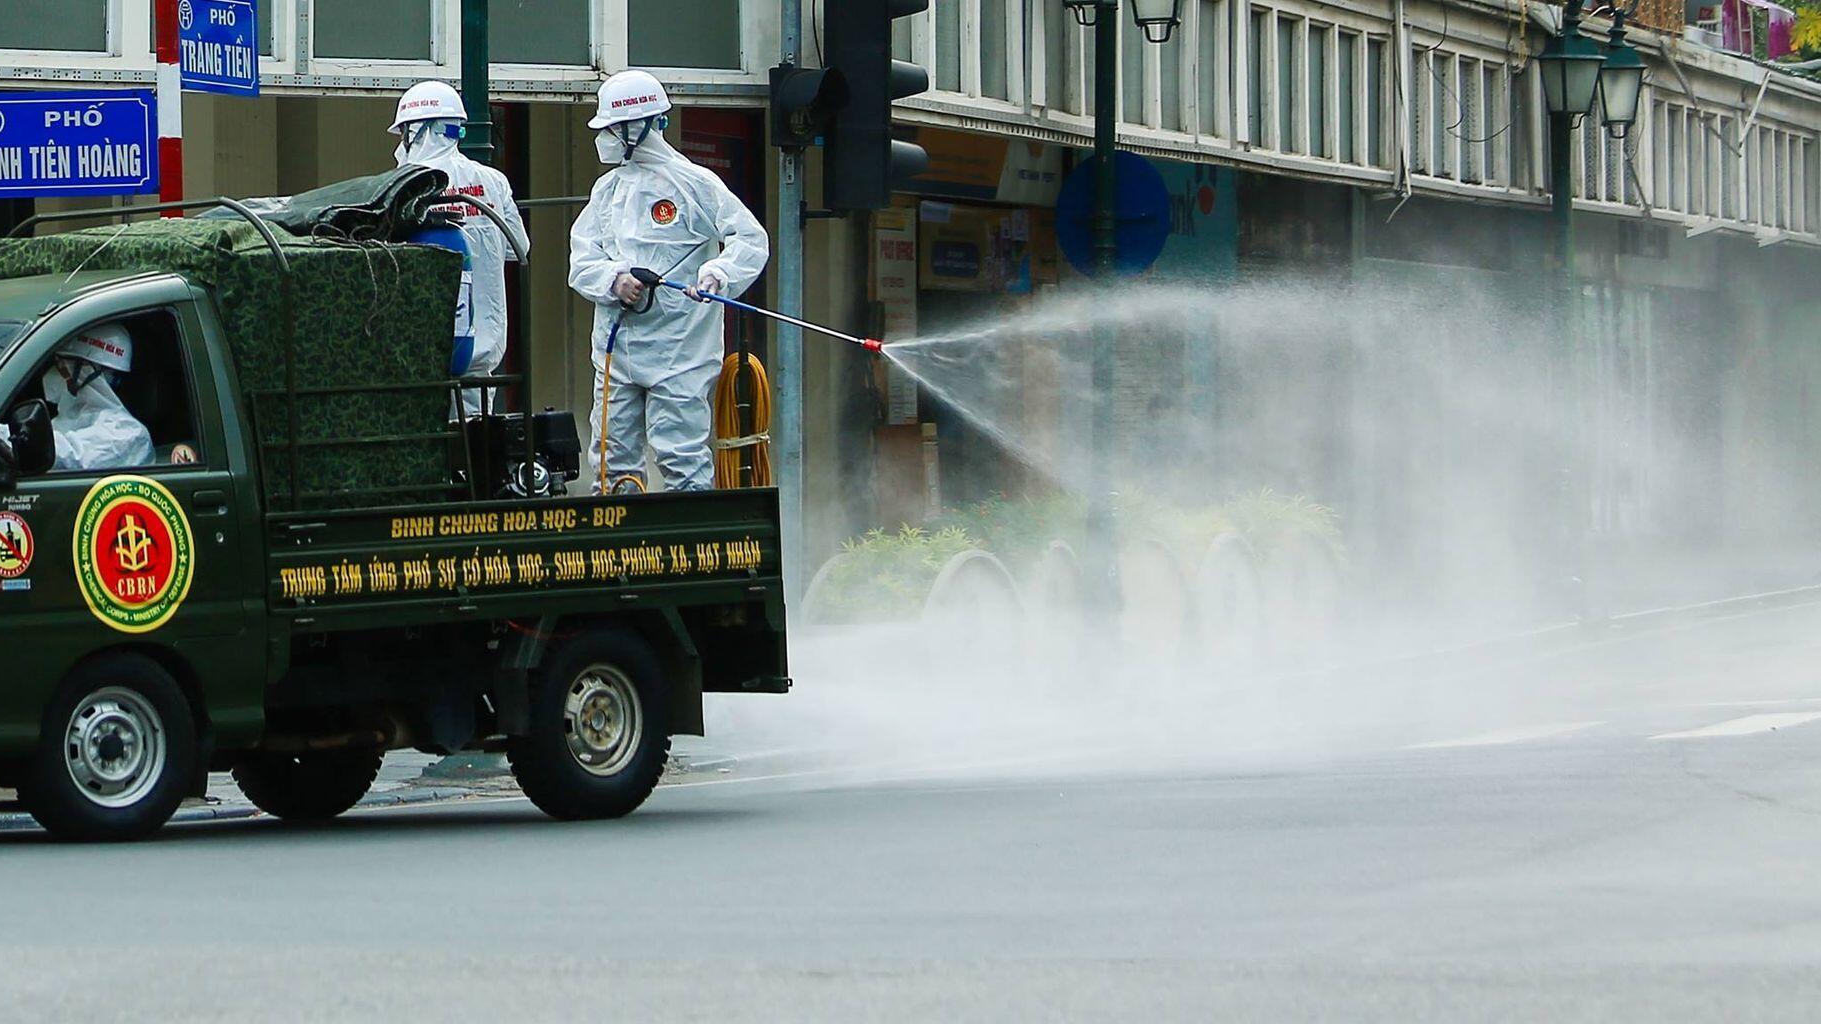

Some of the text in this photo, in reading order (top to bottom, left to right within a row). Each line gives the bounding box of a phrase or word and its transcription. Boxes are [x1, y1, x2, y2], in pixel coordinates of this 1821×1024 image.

[210, 3, 236, 26] PHỐ
[181, 31, 252, 80] TRÀNG TIỀN
[44, 101, 104, 127] PHỐ
[29, 138, 71, 180] TIÊN
[78, 137, 142, 178] HOÀNG
[391, 517, 434, 538] BINH
[593, 506, 627, 528] BQP
[280, 566, 326, 598] TRUNG
[554, 550, 586, 581] SINH
[696, 542, 720, 574] HẠT
